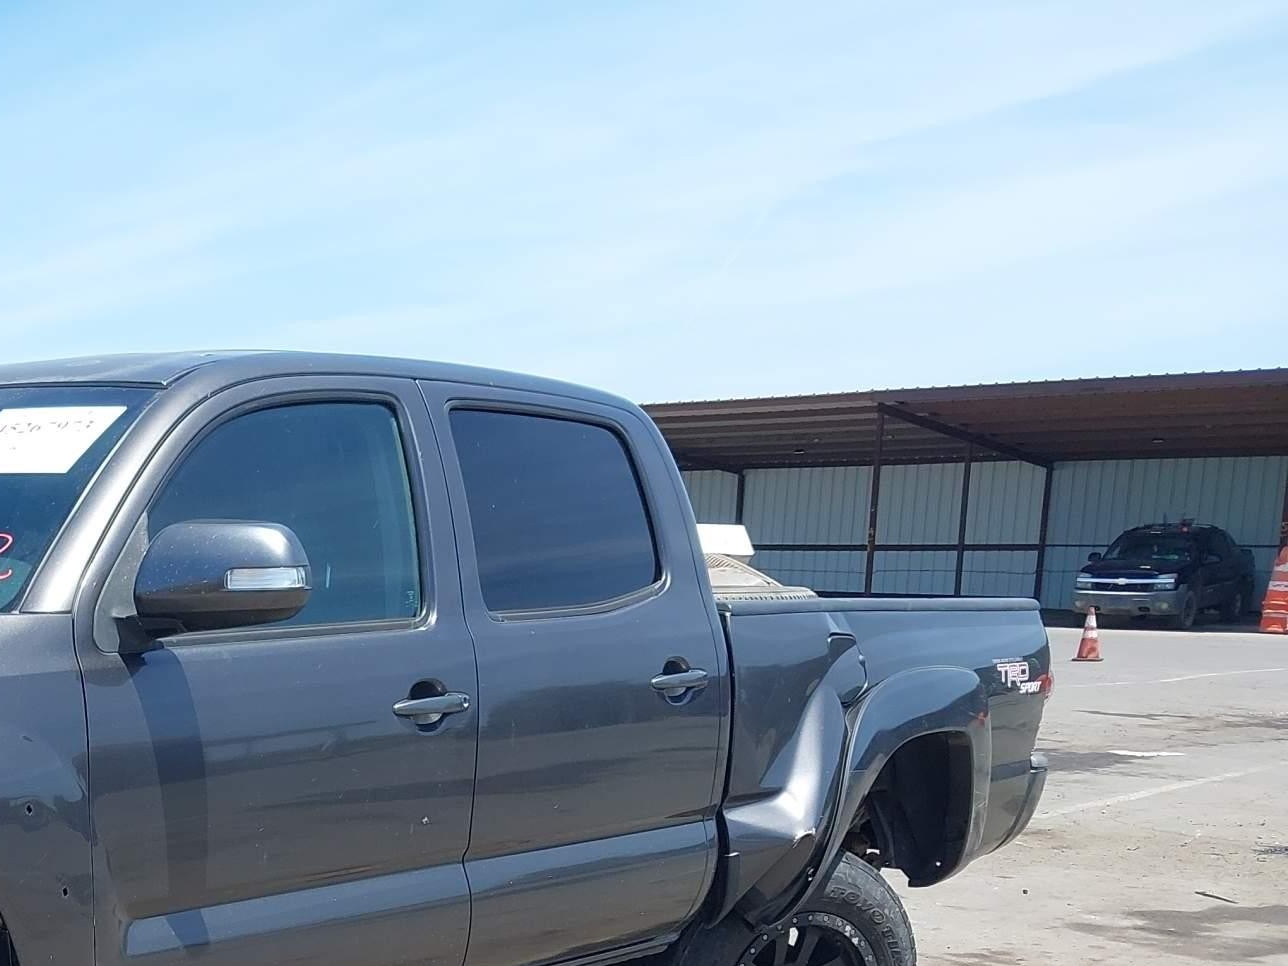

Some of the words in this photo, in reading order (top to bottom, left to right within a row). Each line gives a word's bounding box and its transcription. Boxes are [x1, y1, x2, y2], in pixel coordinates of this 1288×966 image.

[996, 662, 1029, 688] TRD
[1019, 681, 1042, 694] SPORT
[830, 887, 886, 924] TOYO
